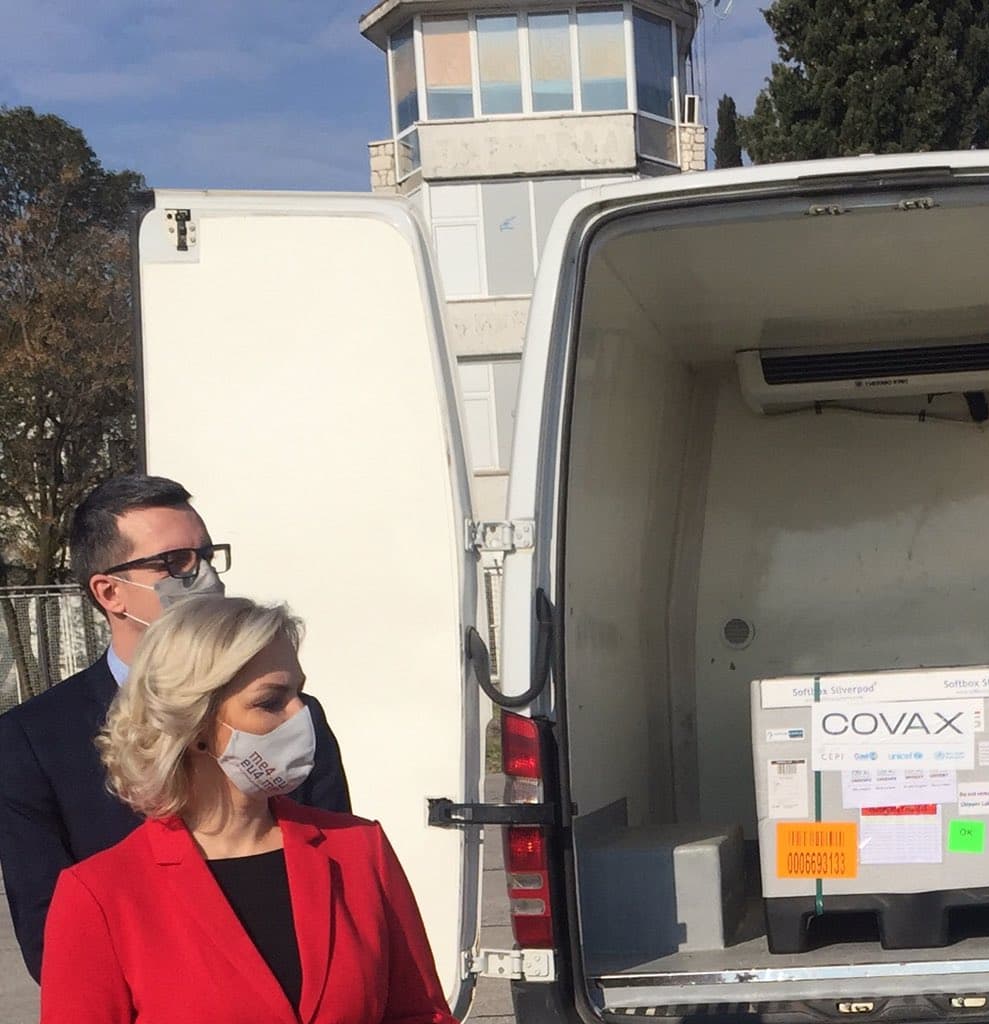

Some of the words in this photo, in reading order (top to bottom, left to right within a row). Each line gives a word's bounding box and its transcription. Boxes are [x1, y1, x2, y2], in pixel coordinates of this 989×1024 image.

[792, 688, 828, 697] Softx
[821, 712, 965, 736] COVAX
[959, 827, 973, 838] OK
[787, 851, 846, 875] 0006693133
